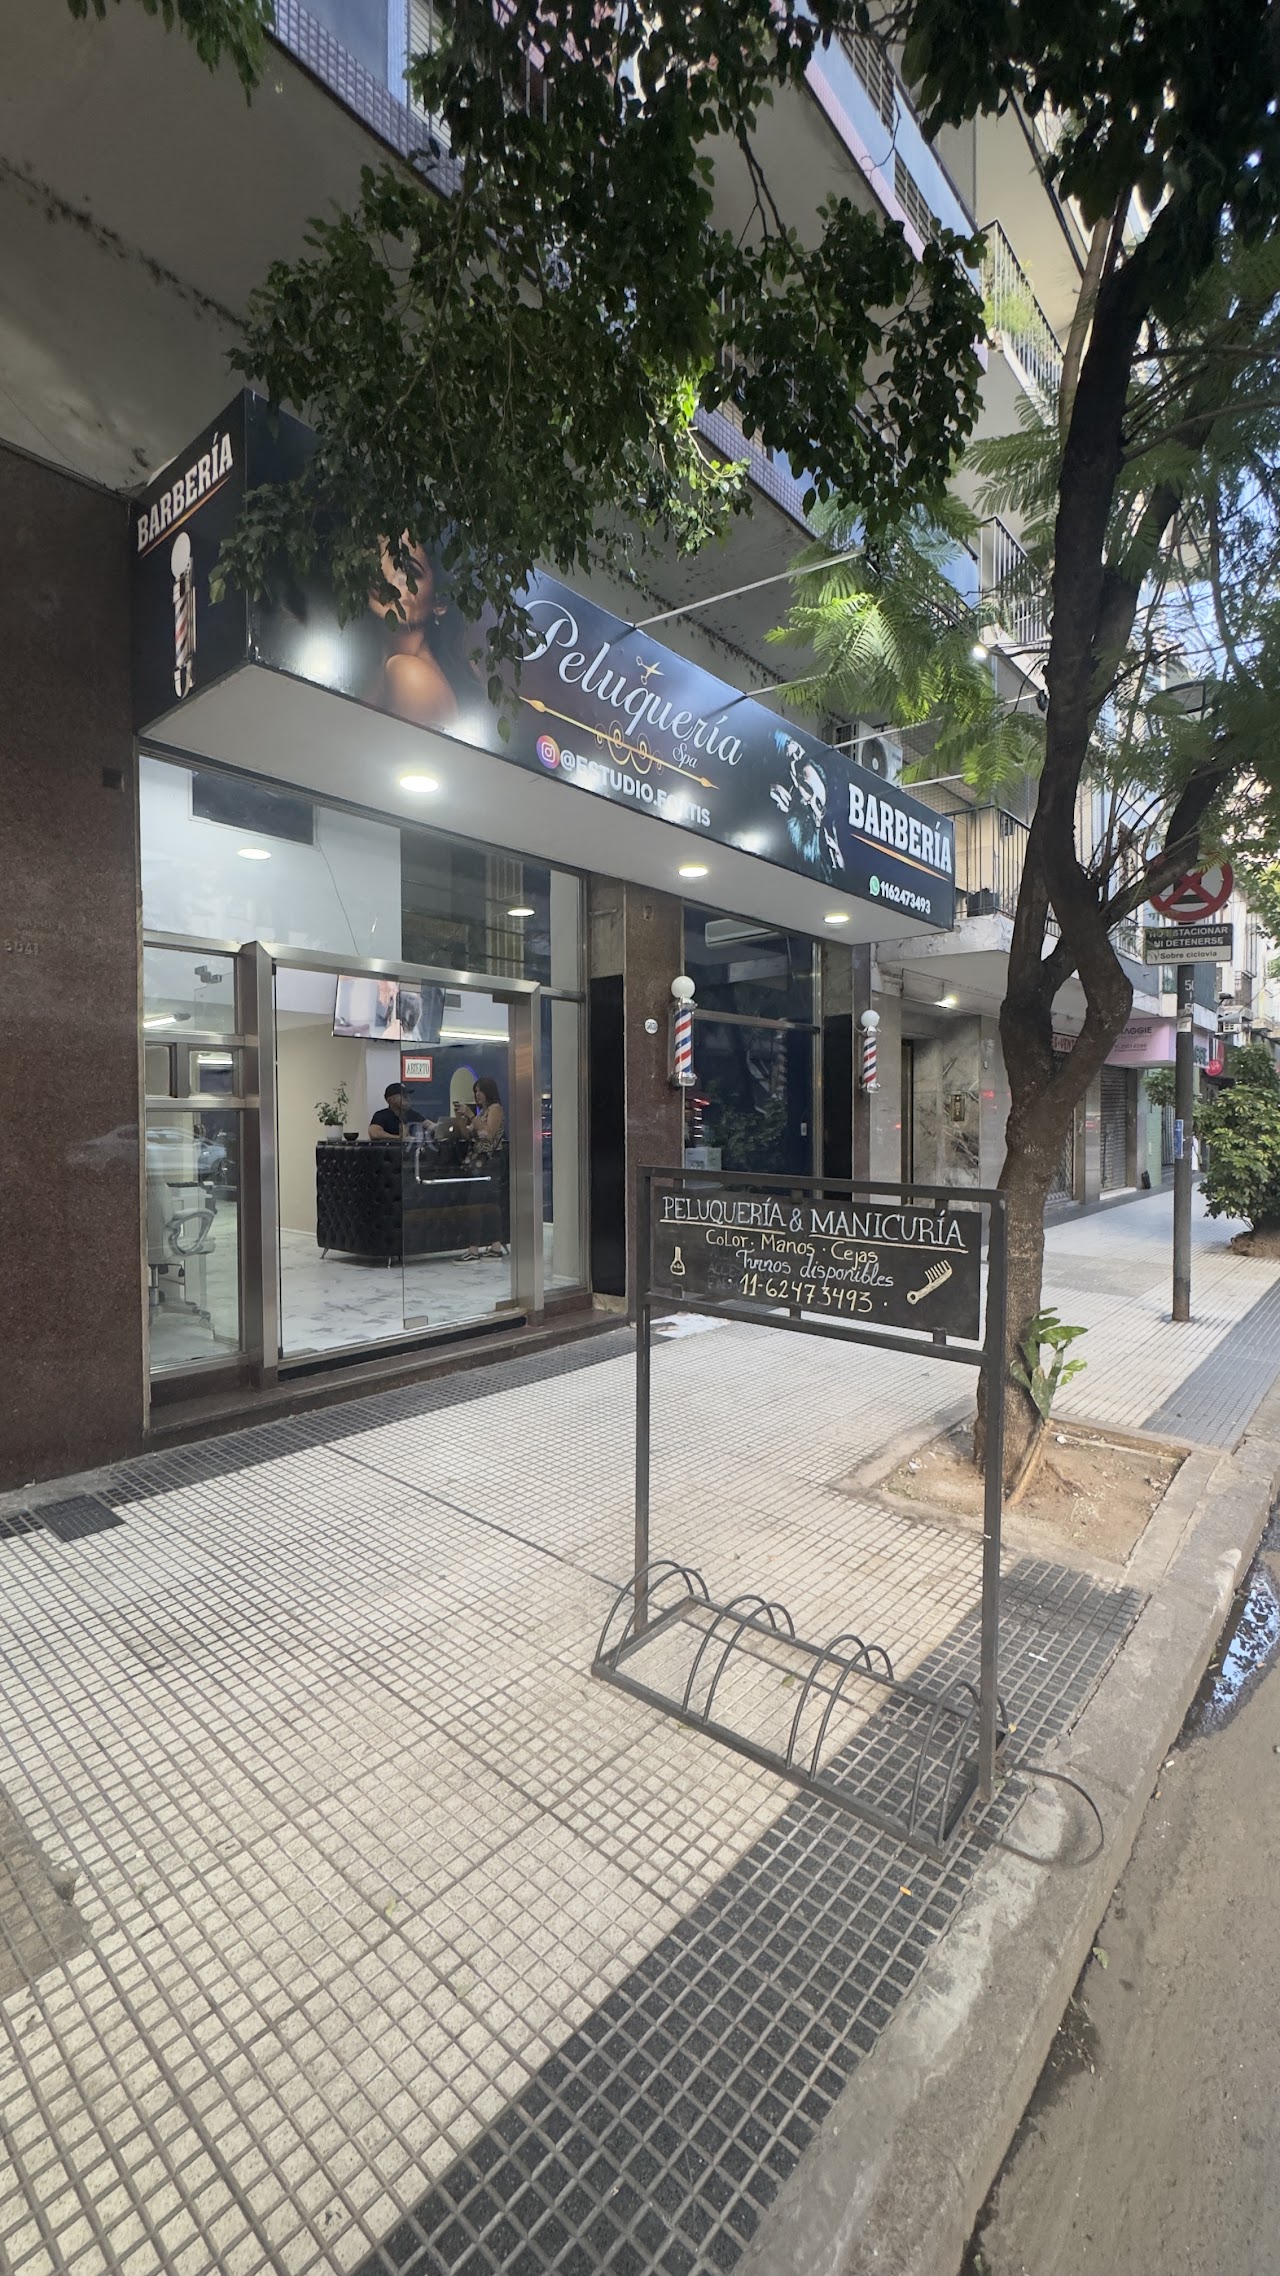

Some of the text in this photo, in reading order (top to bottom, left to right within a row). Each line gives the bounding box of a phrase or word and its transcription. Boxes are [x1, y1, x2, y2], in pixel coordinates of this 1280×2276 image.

[137, 431, 233, 553] BARBERÍA
[514, 599, 743, 766] Peluquería
[672, 742, 698, 769] Spa
[849, 782, 952, 874] BARBERÍA
[880, 880, 931, 915] 1162473493
[1160, 952, 1184, 960] Sobre
[1165, 936, 1224, 947] DETENERSE
[1118, 1026, 1153, 1035] AGGIE
[406, 1062, 430, 1075] ABIERTO
[662, 1196, 966, 1248] PELUQUERÍA & MANICURÍA
[736, 1249, 791, 1275] Turnos
[799, 1253, 894, 1288] disponibles
[761, 1234, 815, 1255] Manos
[830, 1241, 878, 1270] Cejas
